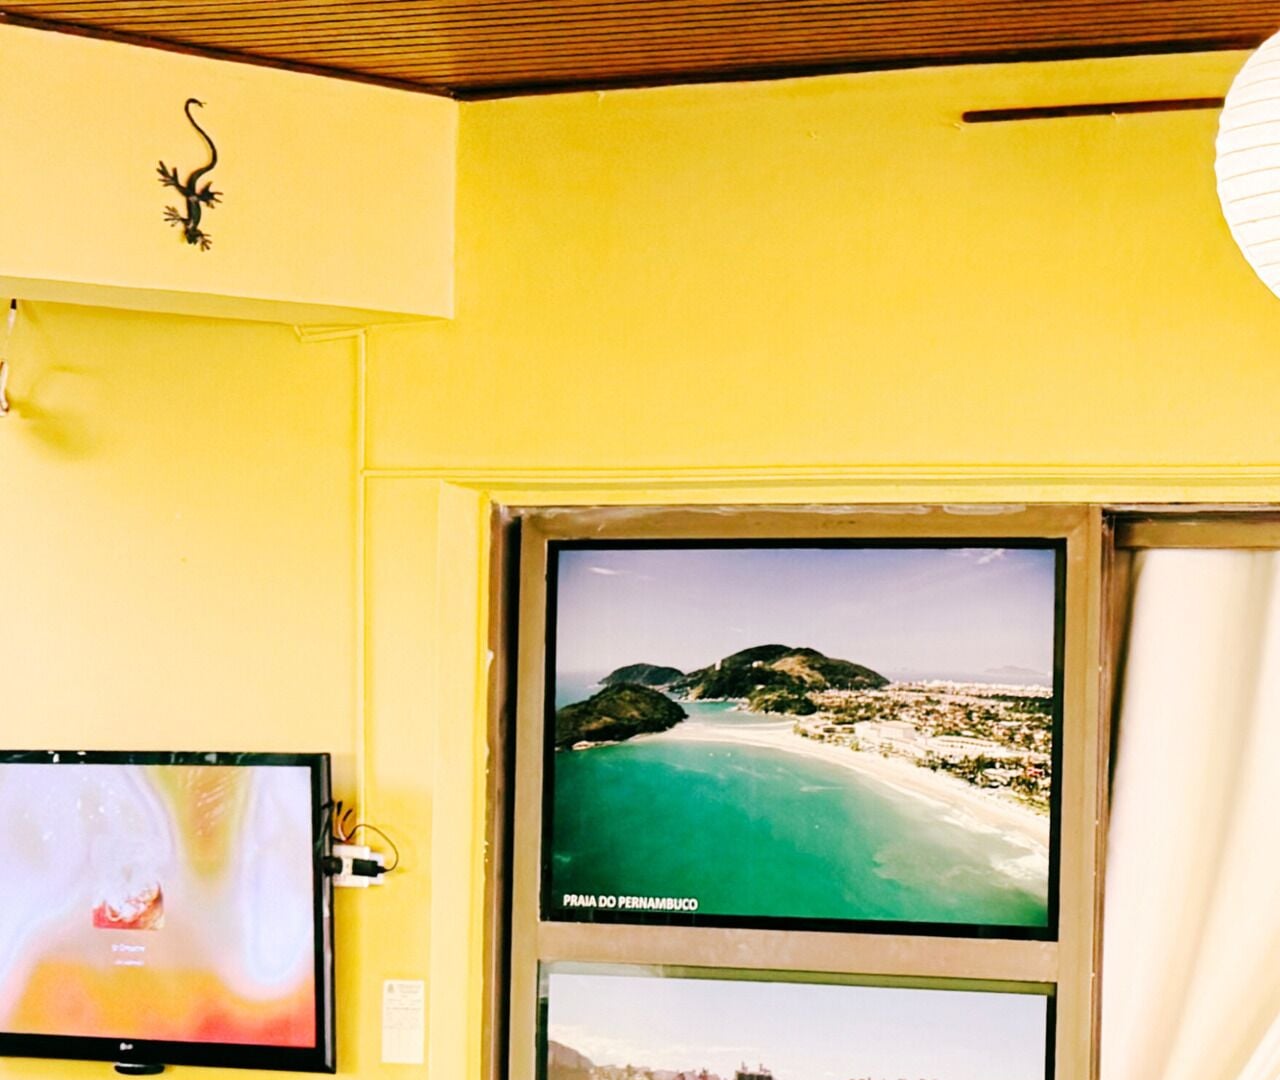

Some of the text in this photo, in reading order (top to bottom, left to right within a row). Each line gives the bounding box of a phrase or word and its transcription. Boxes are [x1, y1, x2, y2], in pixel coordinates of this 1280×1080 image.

[563, 894, 698, 911] PRAIA DO PERNAMBUCO
